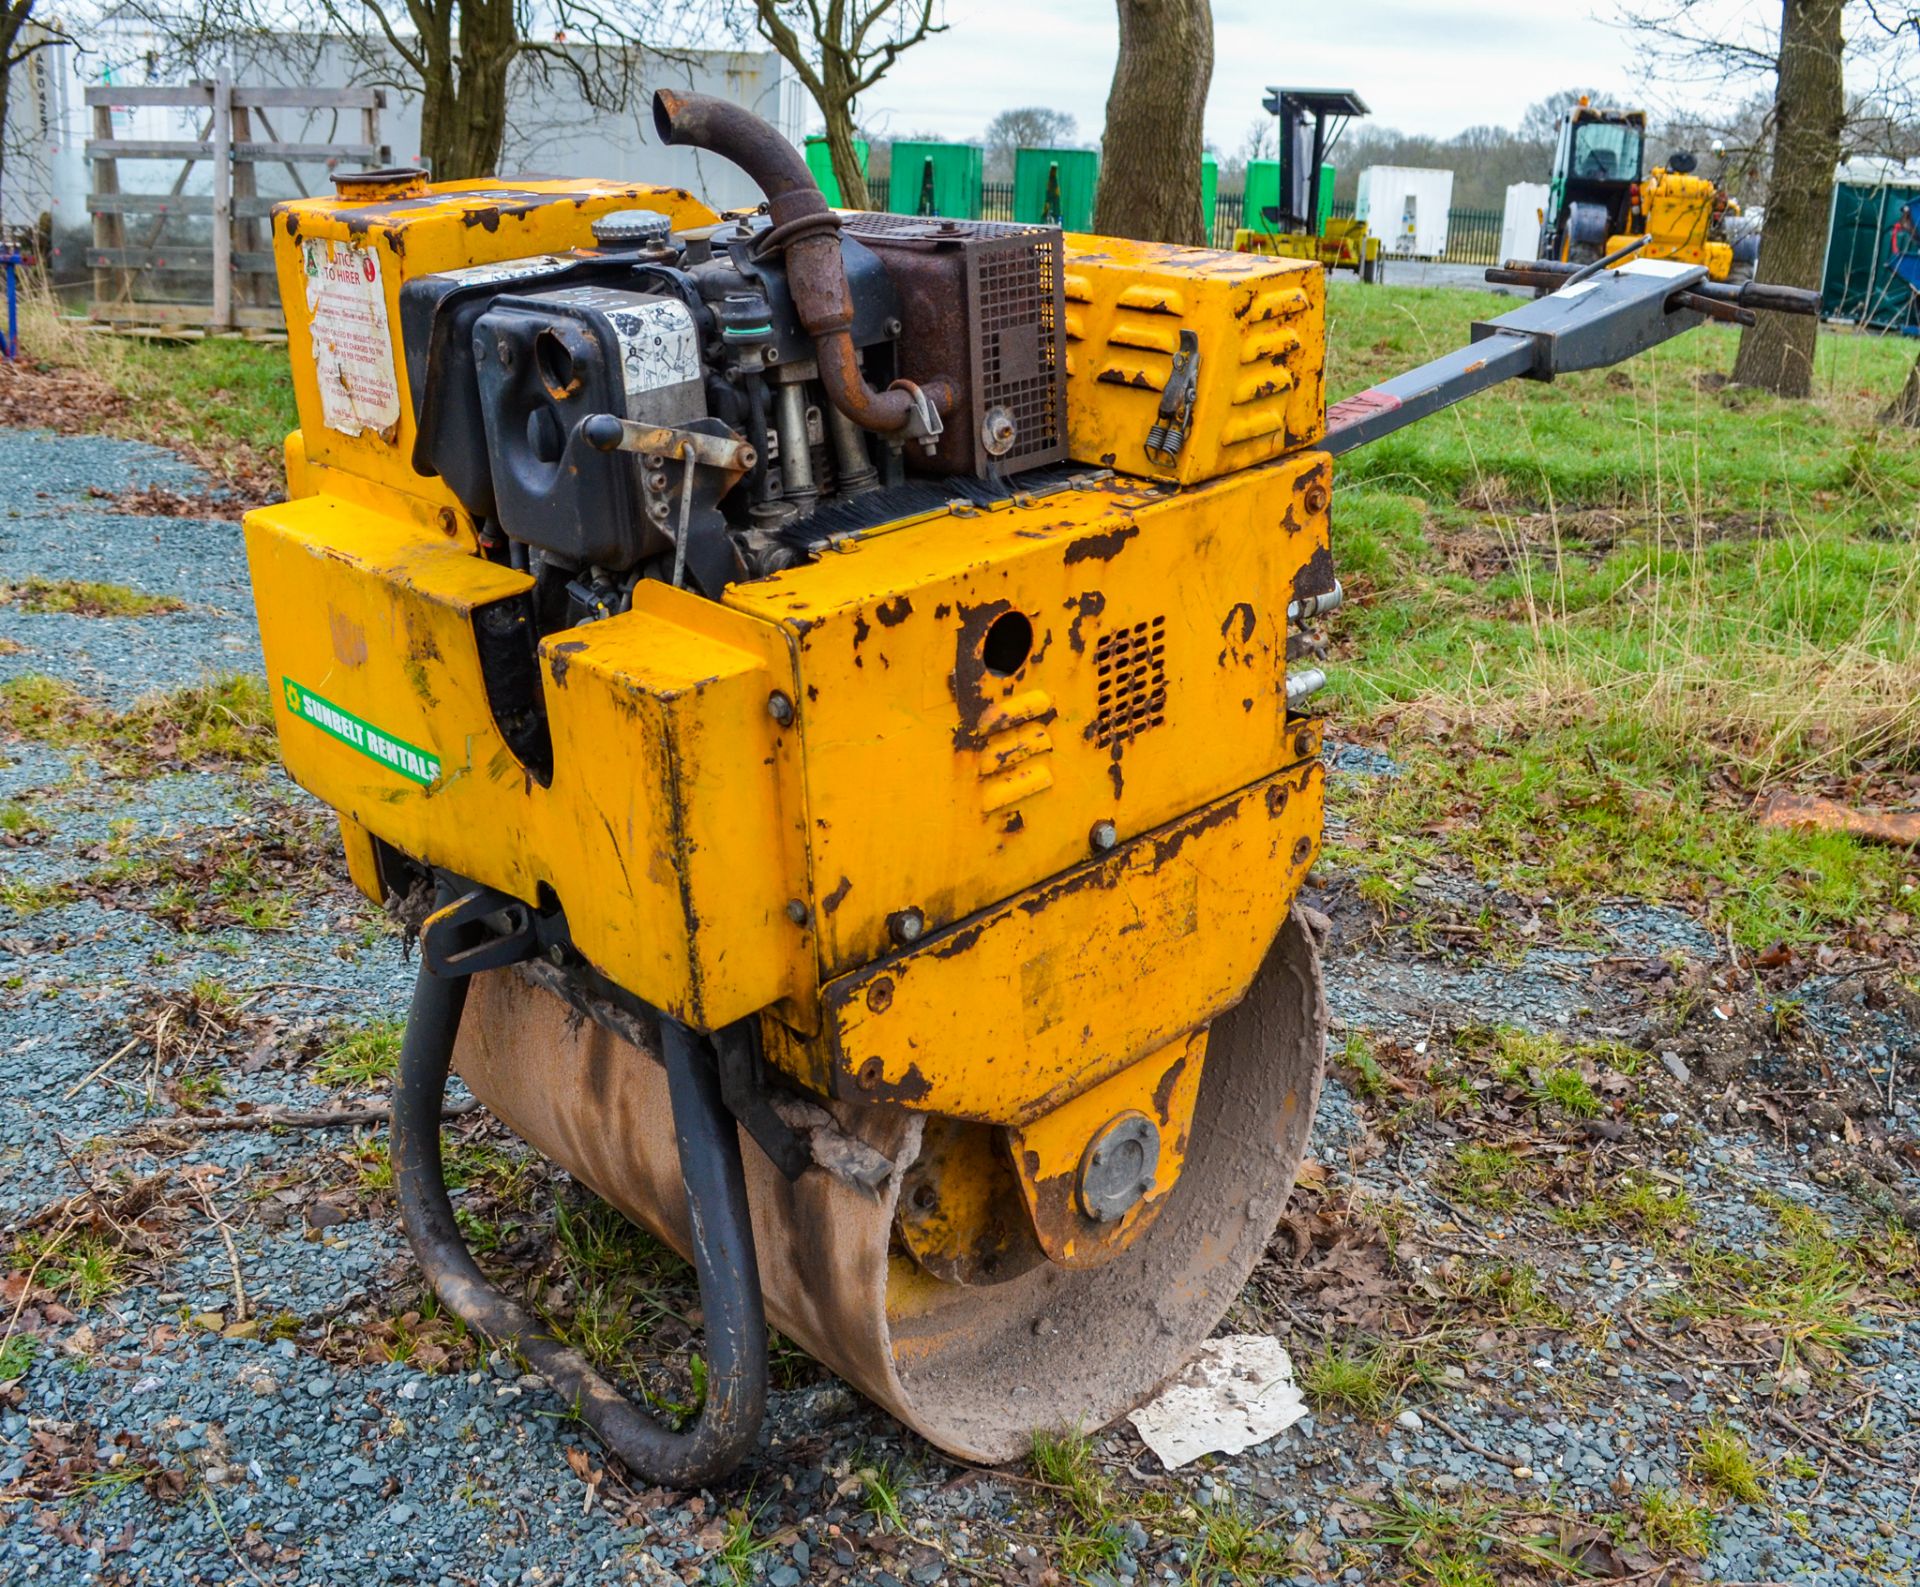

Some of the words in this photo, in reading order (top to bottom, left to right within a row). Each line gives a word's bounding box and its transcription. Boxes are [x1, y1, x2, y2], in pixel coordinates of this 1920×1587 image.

[324, 266, 336, 281] TO
[337, 270, 361, 285] HIRER
[354, 352, 376, 365] CONTRACT
[303, 695, 364, 746] SUNBELT
[366, 730, 441, 782] RENTALS
